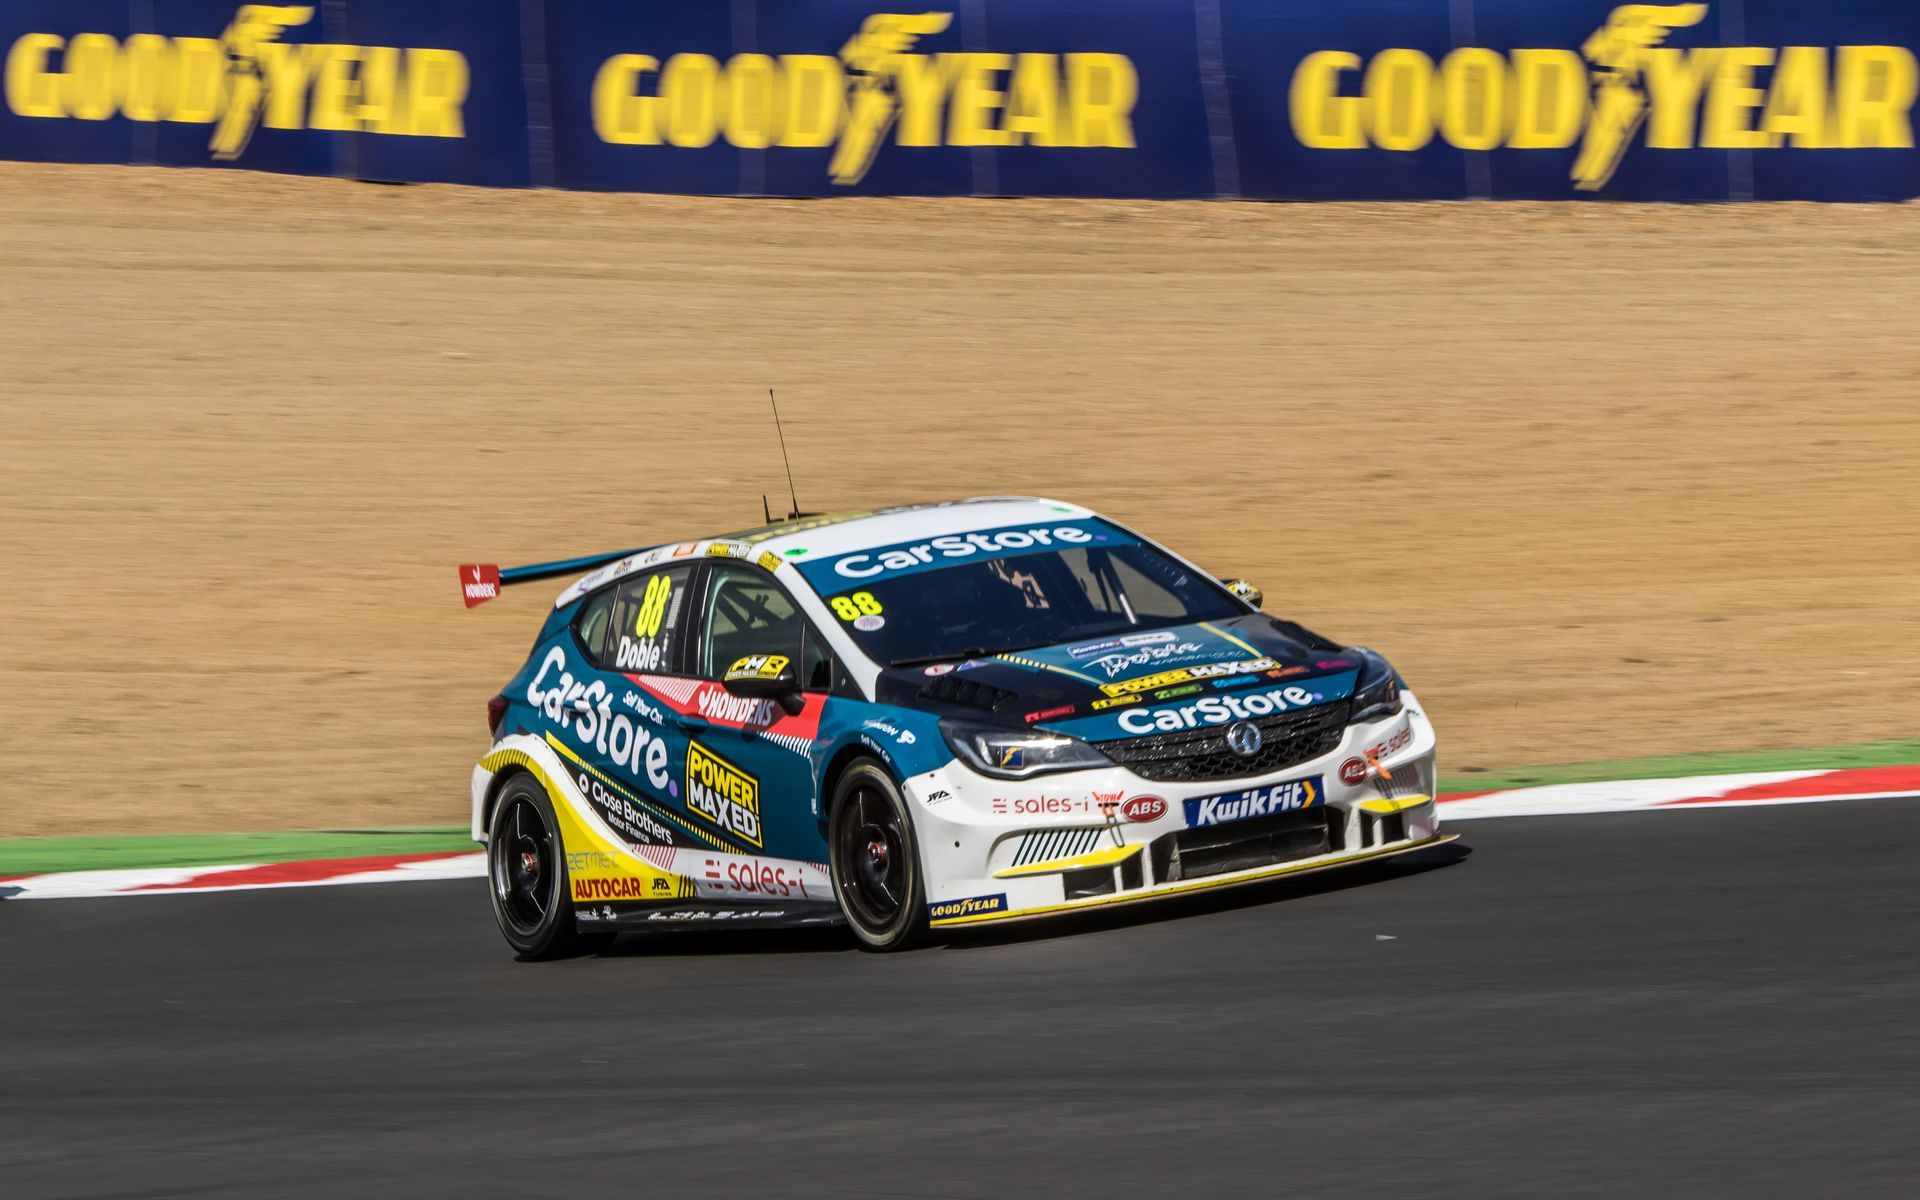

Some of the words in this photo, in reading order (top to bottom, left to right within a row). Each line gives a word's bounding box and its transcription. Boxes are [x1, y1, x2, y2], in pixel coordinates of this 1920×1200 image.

[5, 33, 469, 137] GOODYEAR
[591, 52, 1138, 148] GOODYEAR
[1289, 44, 1917, 151] GOODYEAR
[636, 575, 671, 637] 88
[831, 591, 883, 621] 88
[616, 636, 660, 670] Doble
[1107, 669, 1192, 693] POWER
[1189, 658, 1275, 678] MAXED
[622, 690, 638, 708] Sell
[635, 697, 651, 717] Your
[706, 690, 776, 726] HOWDENS
[689, 749, 755, 812] POWER
[592, 781, 622, 815] Close
[623, 799, 673, 845] Brothers
[689, 777, 757, 838] MAXED
[1015, 795, 1088, 814] sales-i
[1128, 800, 1162, 817] ABS
[608, 810, 625, 831] Motor
[625, 822, 650, 844] Finance
[575, 877, 642, 898] AUTOCAR
[651, 878, 670, 890] JFA
[728, 859, 808, 898] sales-i
[931, 898, 999, 917] GOODYEAR
